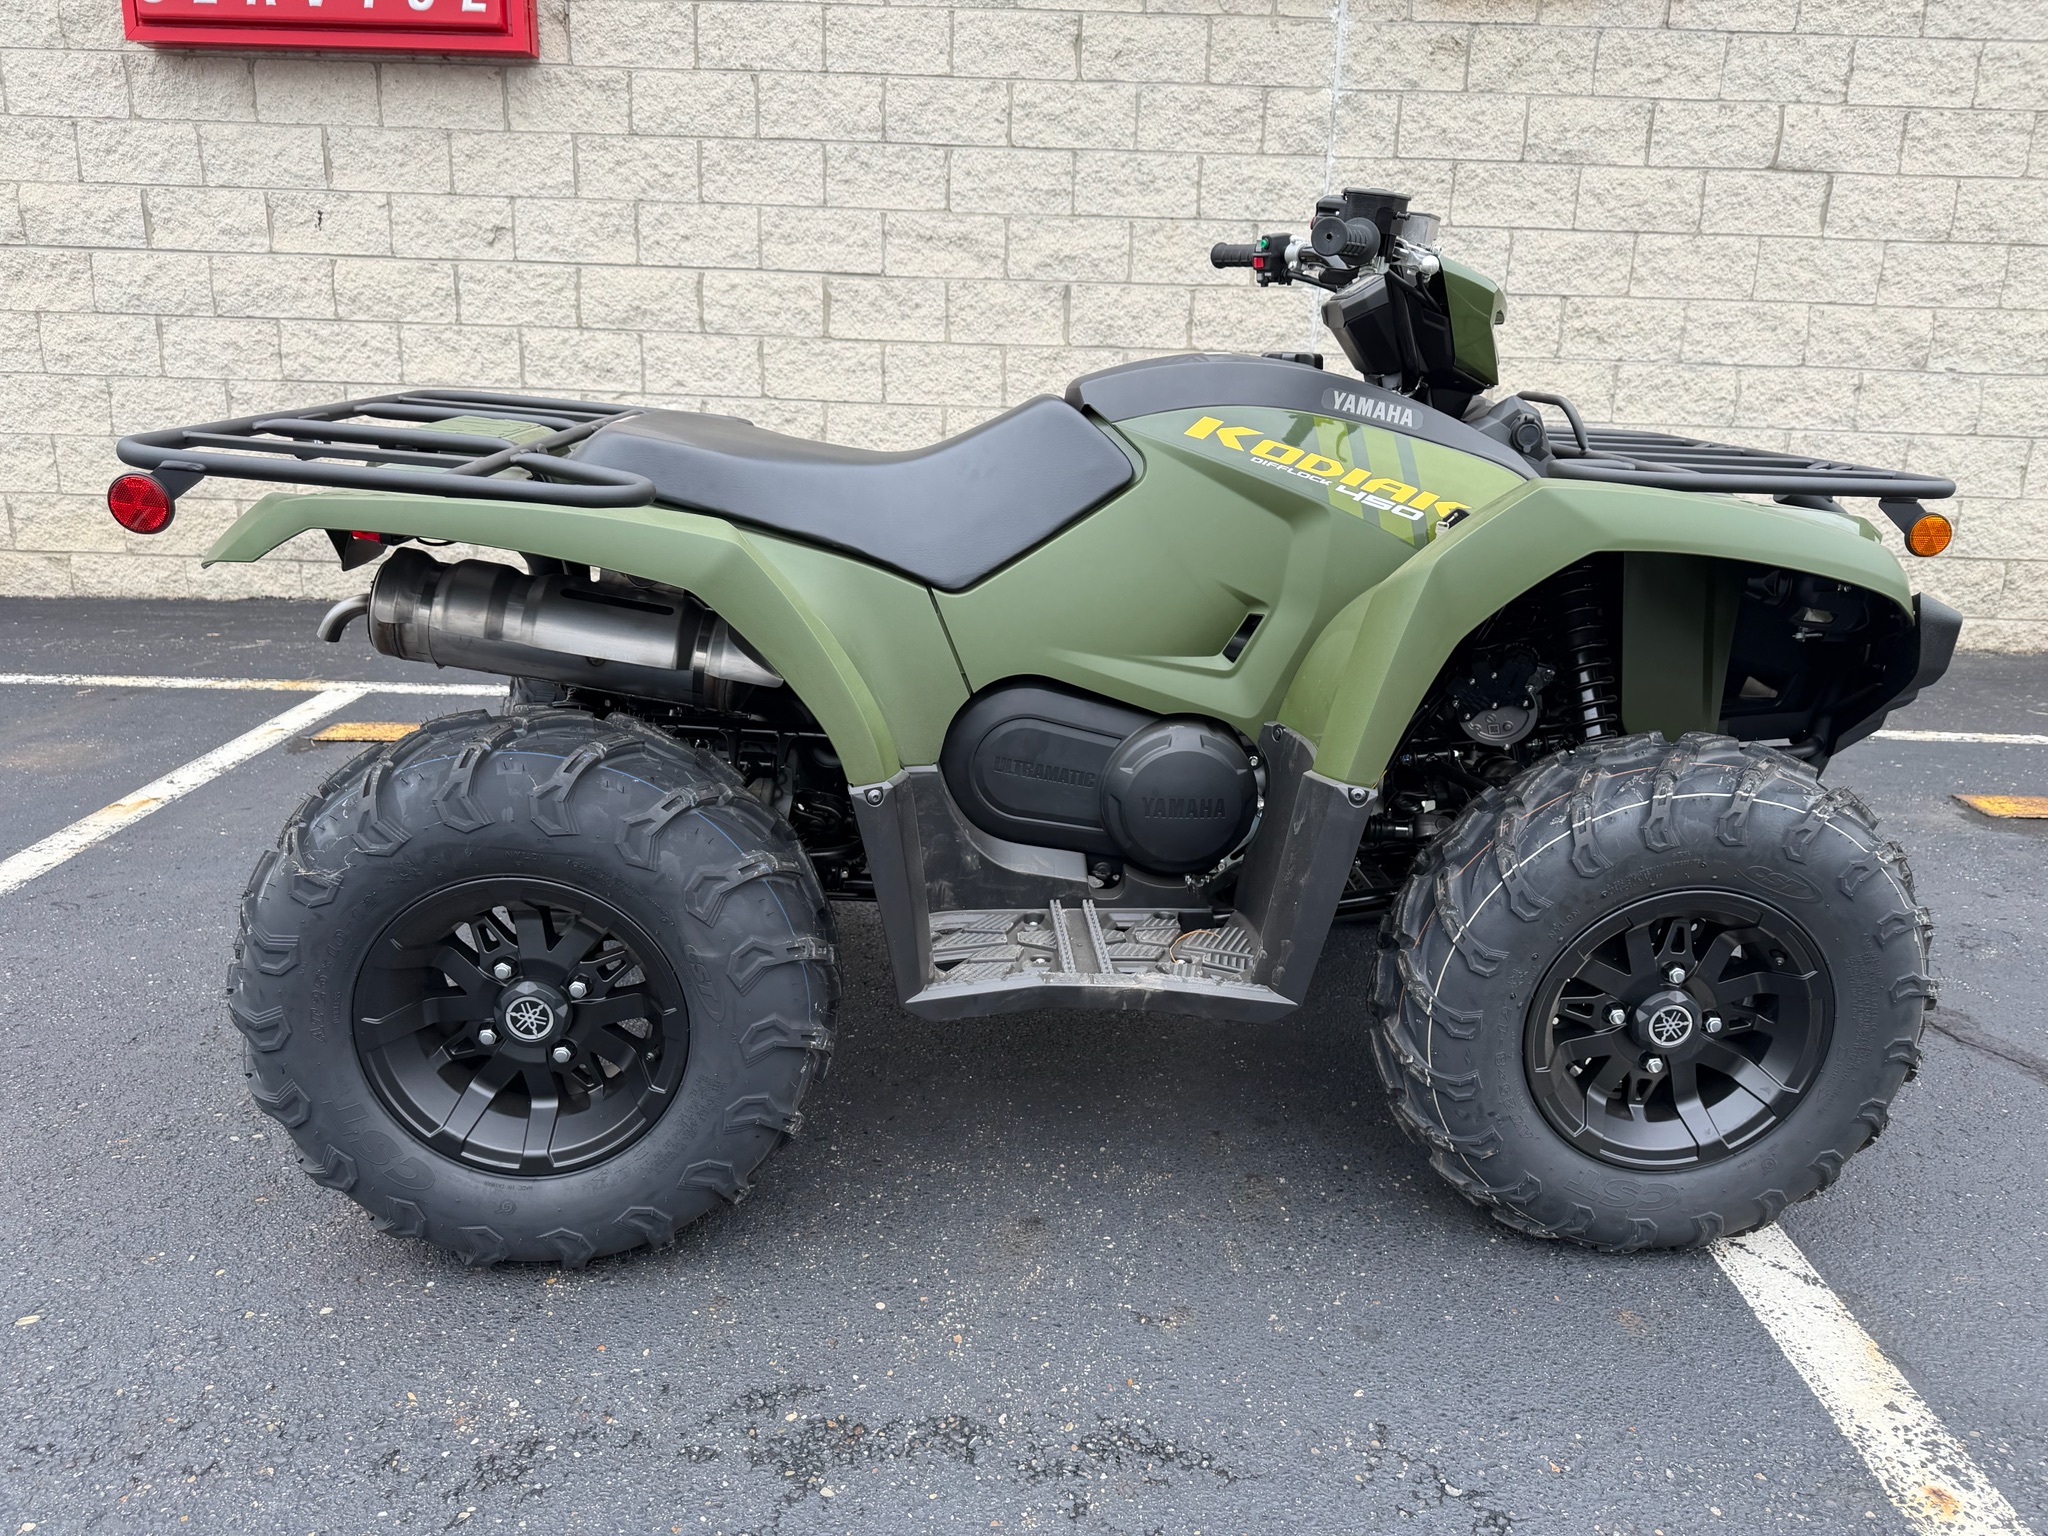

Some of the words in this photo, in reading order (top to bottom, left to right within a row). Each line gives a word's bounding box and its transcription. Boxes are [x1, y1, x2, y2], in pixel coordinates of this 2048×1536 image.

[1332, 390, 1414, 428] YAMAHA
[1183, 415, 1472, 519] KODIAK
[1250, 456, 1333, 486] DIFFLOCK
[1334, 484, 1425, 521] 450
[992, 755, 1097, 790] ULTRAMATIC
[1141, 796, 1227, 820] YAMAHA
[320, 1099, 436, 1191] CST
[1563, 1169, 1681, 1212] CST
